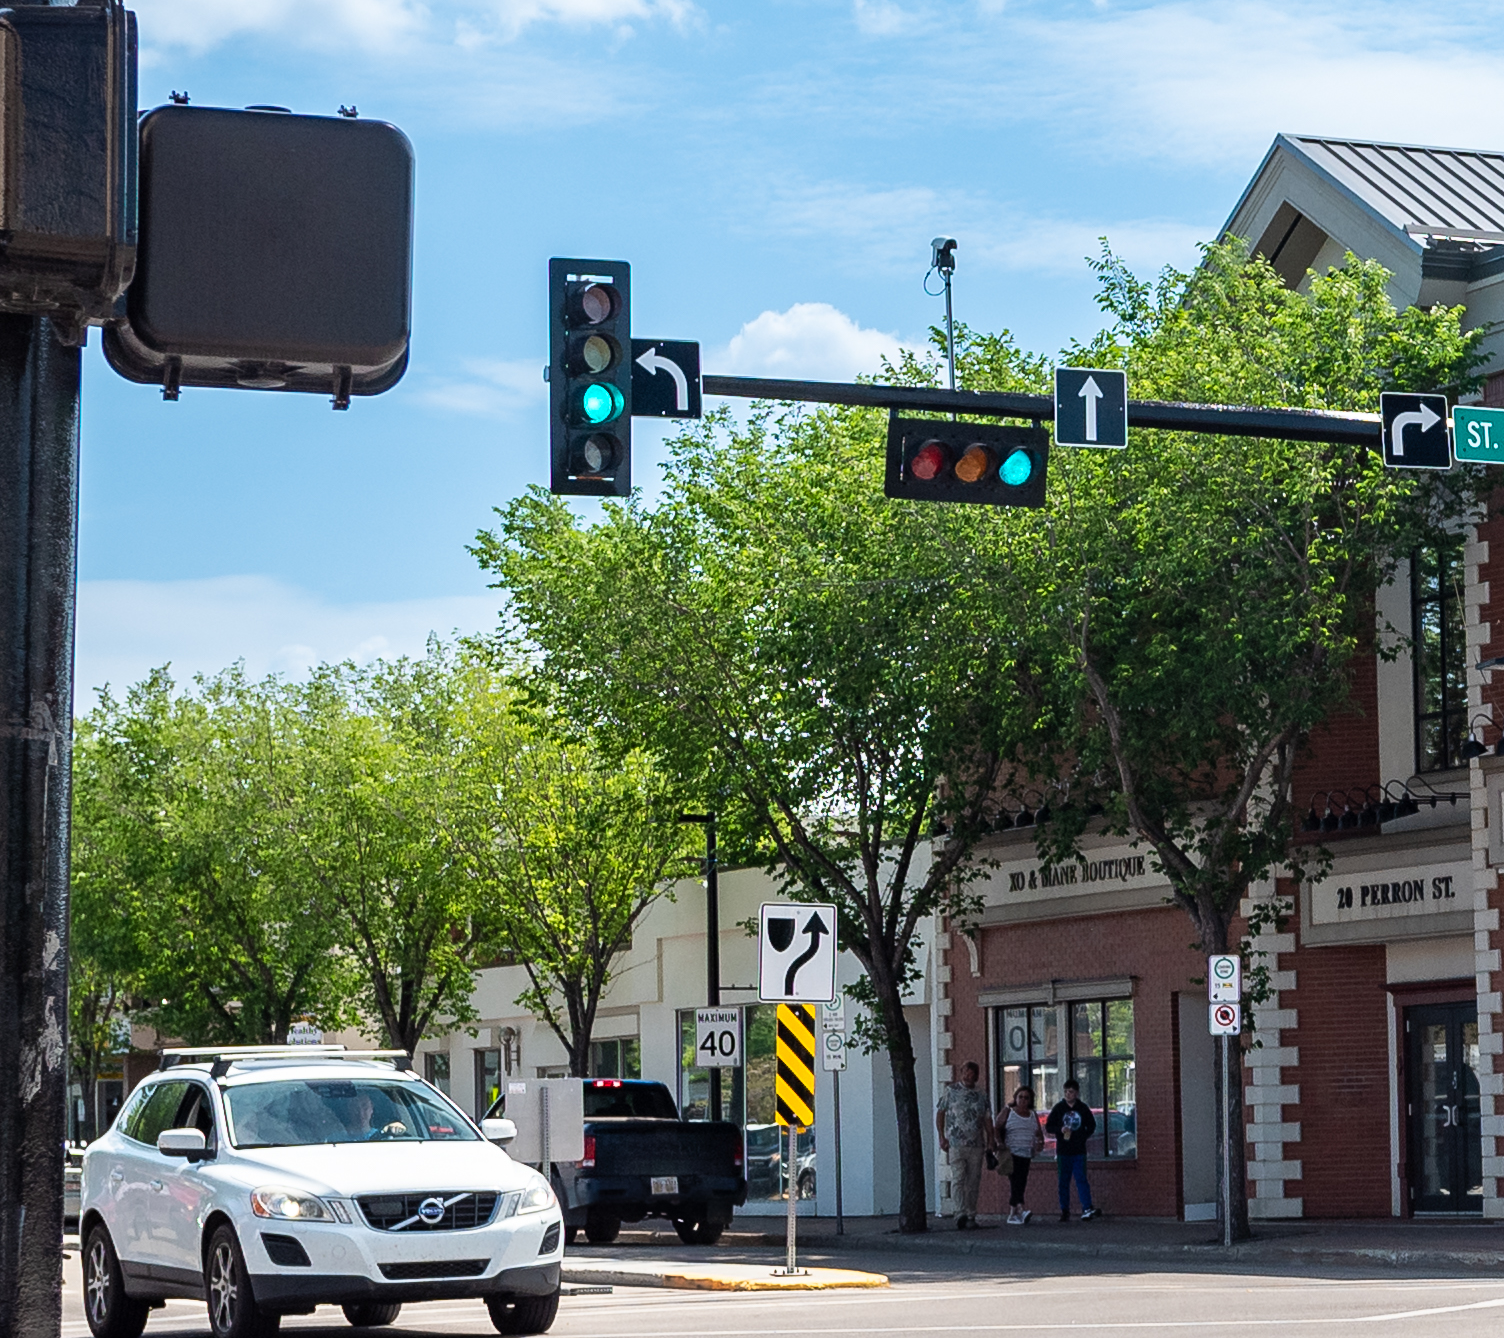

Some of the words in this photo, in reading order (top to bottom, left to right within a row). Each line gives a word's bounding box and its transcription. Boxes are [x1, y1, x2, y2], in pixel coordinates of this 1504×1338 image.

[1467, 420, 1499, 449] ST.
[1028, 870, 1038, 890] &
[1081, 855, 1146, 883] BOUTIQUE
[1337, 886, 1354, 909] 20
[1360, 879, 1425, 907] PERRON
[1431, 875, 1456, 900] ST.
[697, 1012, 737, 1023] MAXIMUM
[699, 1030, 736, 1057] 40
